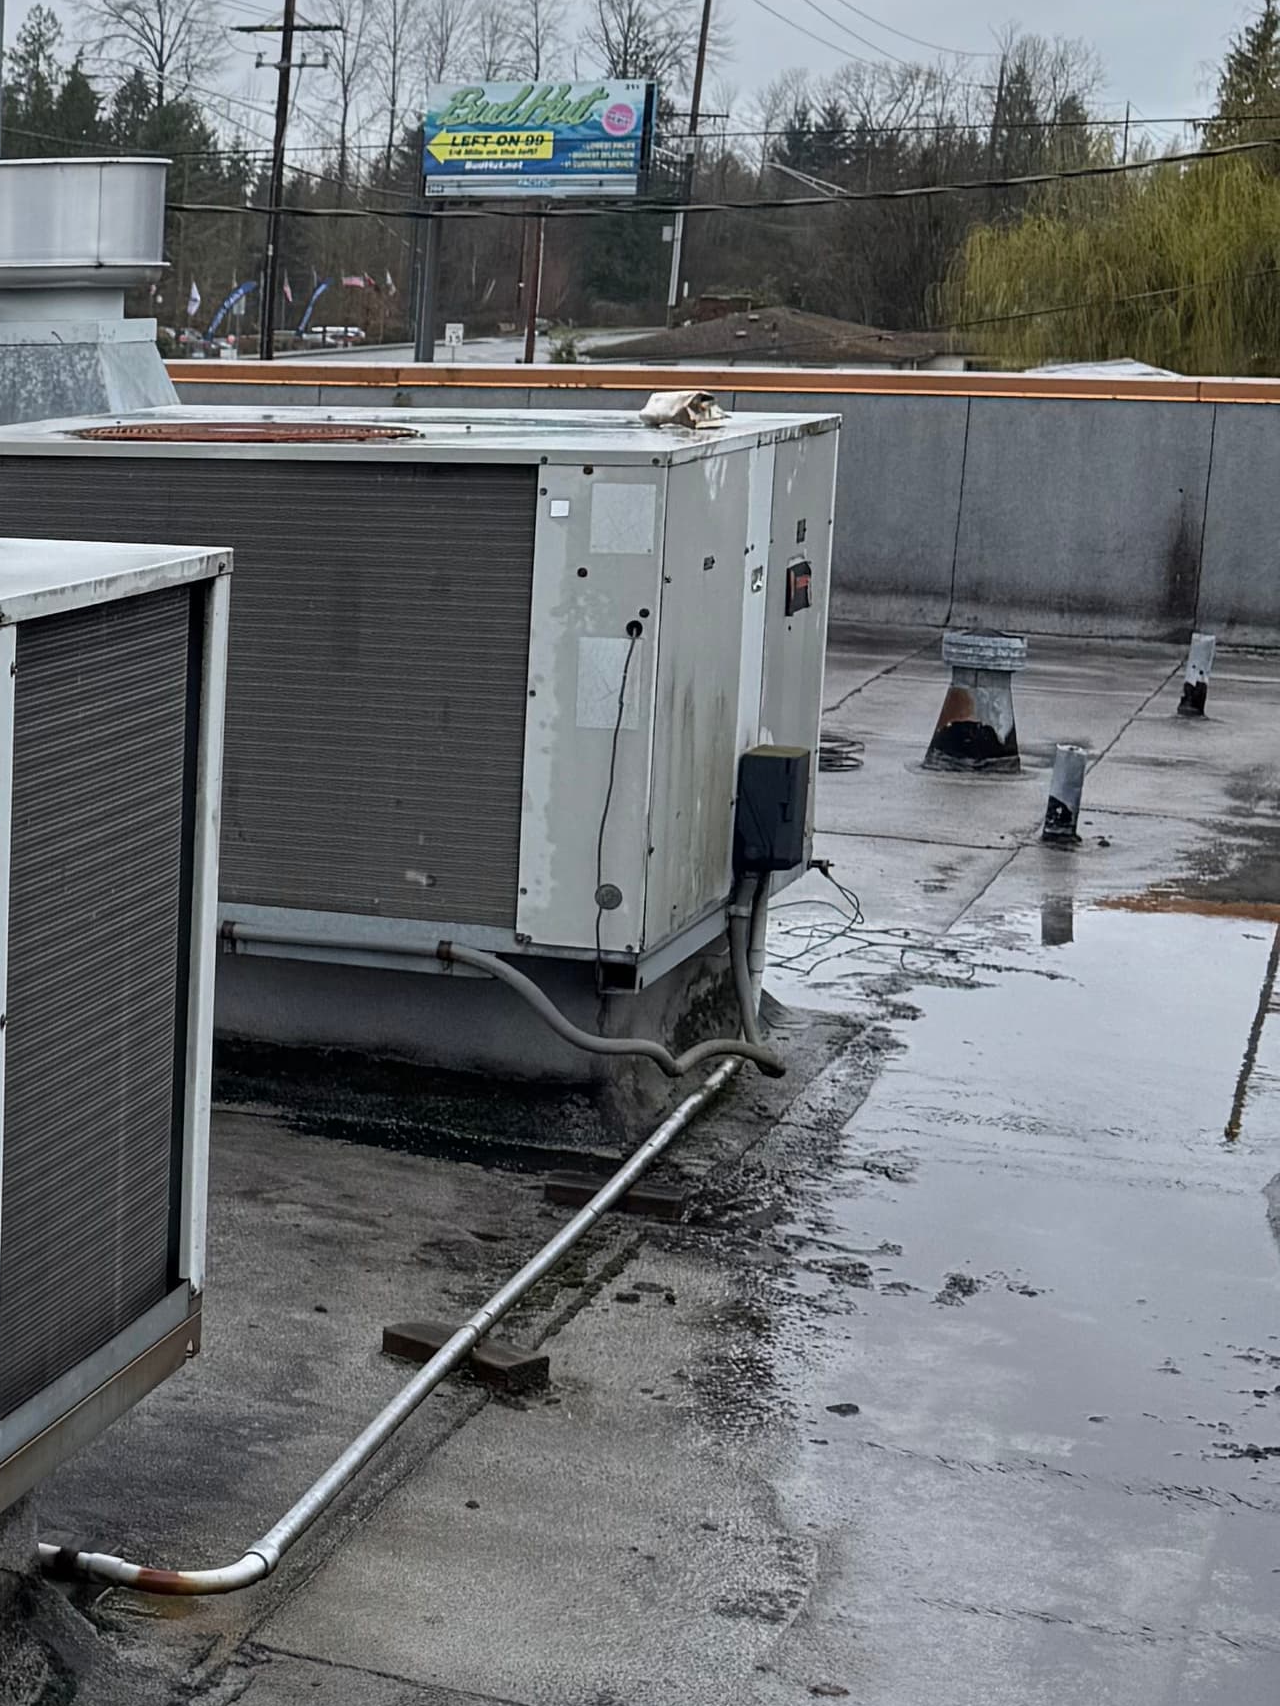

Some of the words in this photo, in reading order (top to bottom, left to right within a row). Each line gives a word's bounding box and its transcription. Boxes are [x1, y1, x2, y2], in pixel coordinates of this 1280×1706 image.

[436, 85, 534, 126] Bud
[517, 84, 609, 126] Hut
[451, 135, 493, 147] LEFT
[496, 134, 521, 147] ON
